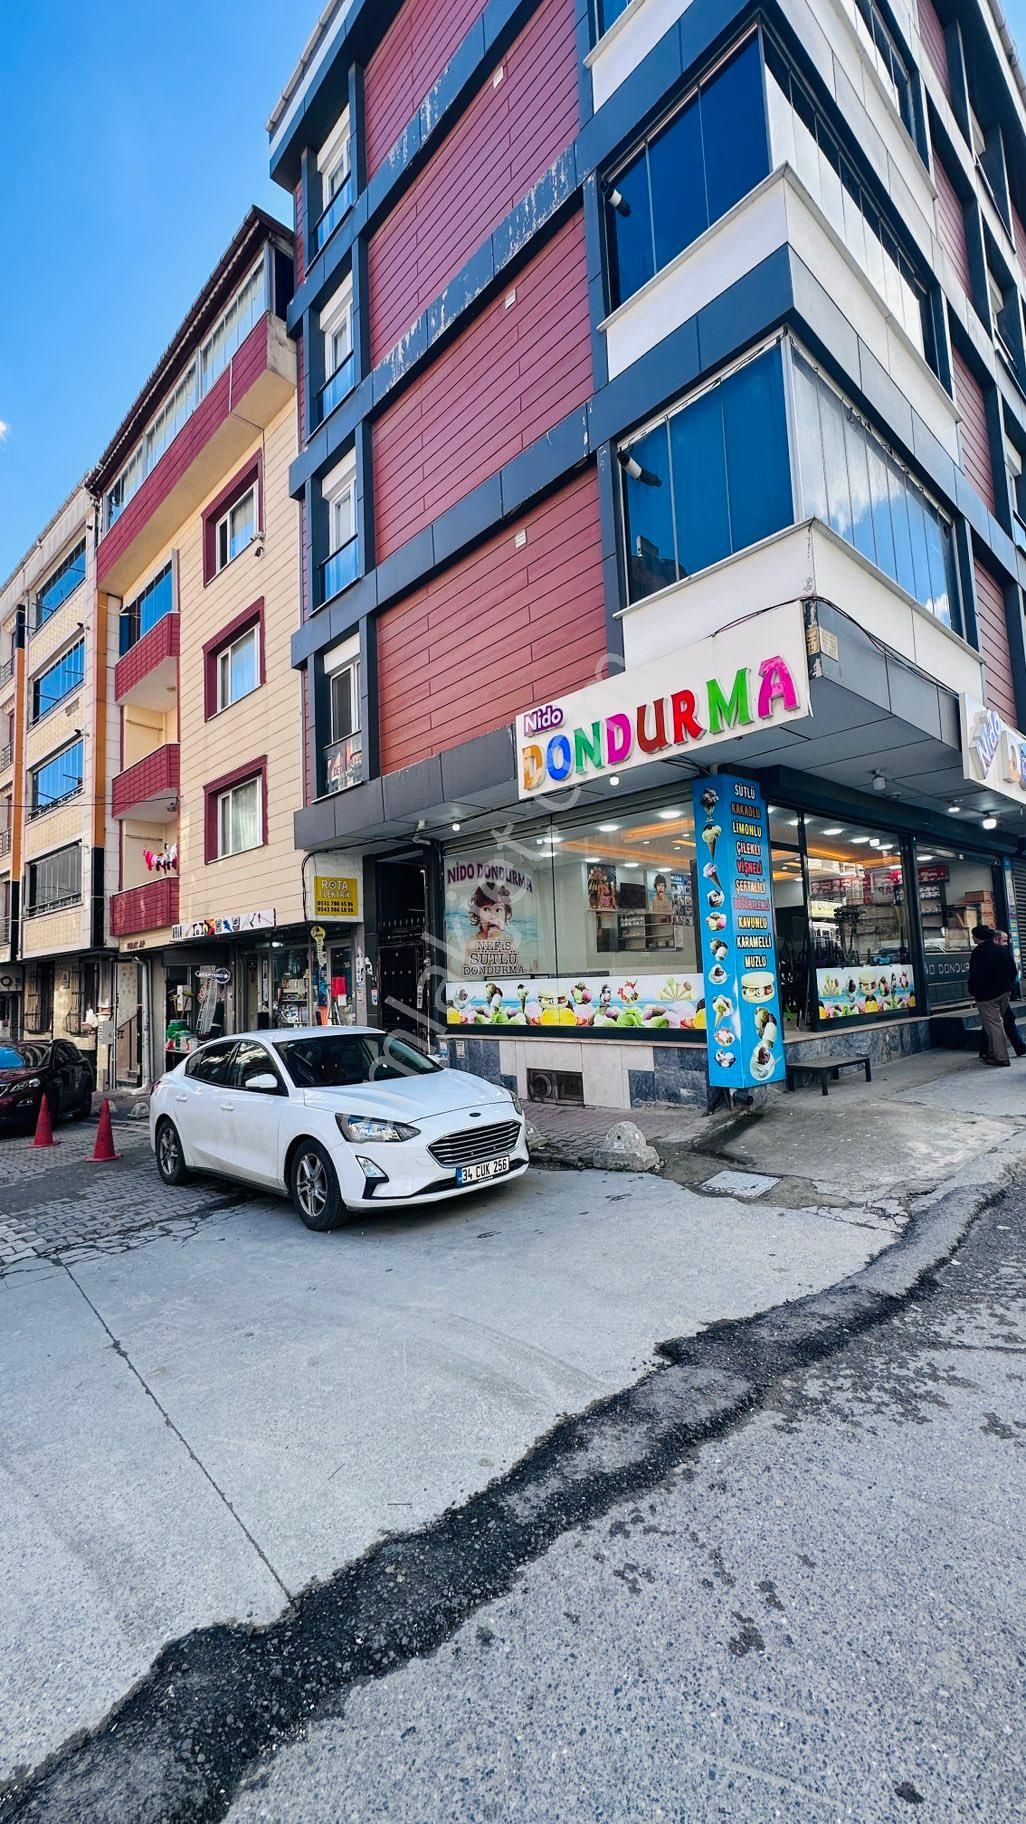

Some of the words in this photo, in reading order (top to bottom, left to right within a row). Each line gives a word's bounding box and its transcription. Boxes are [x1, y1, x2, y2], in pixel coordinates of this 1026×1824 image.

[521, 655, 801, 791] DONDURMA
[524, 705, 564, 736] Nido
[734, 782, 756, 800] SÜTLÜ
[731, 803, 761, 819] KAKAOLU
[732, 820, 762, 838] LİMONLU
[736, 840, 761, 857] ÇİLEKLİ
[321, 879, 348, 891] ROTA
[476, 863, 533, 894] DONDURMA
[738, 916, 768, 929] KAVUNLU
[736, 933, 772, 949] KARAMELLİ
[469, 950, 518, 965] SÜTLÜ
[744, 955, 767, 968] MUZLU
[462, 965, 525, 976] DONDURMA
[462, 1168, 473, 1181] 34
[493, 1158, 507, 1173] 256
